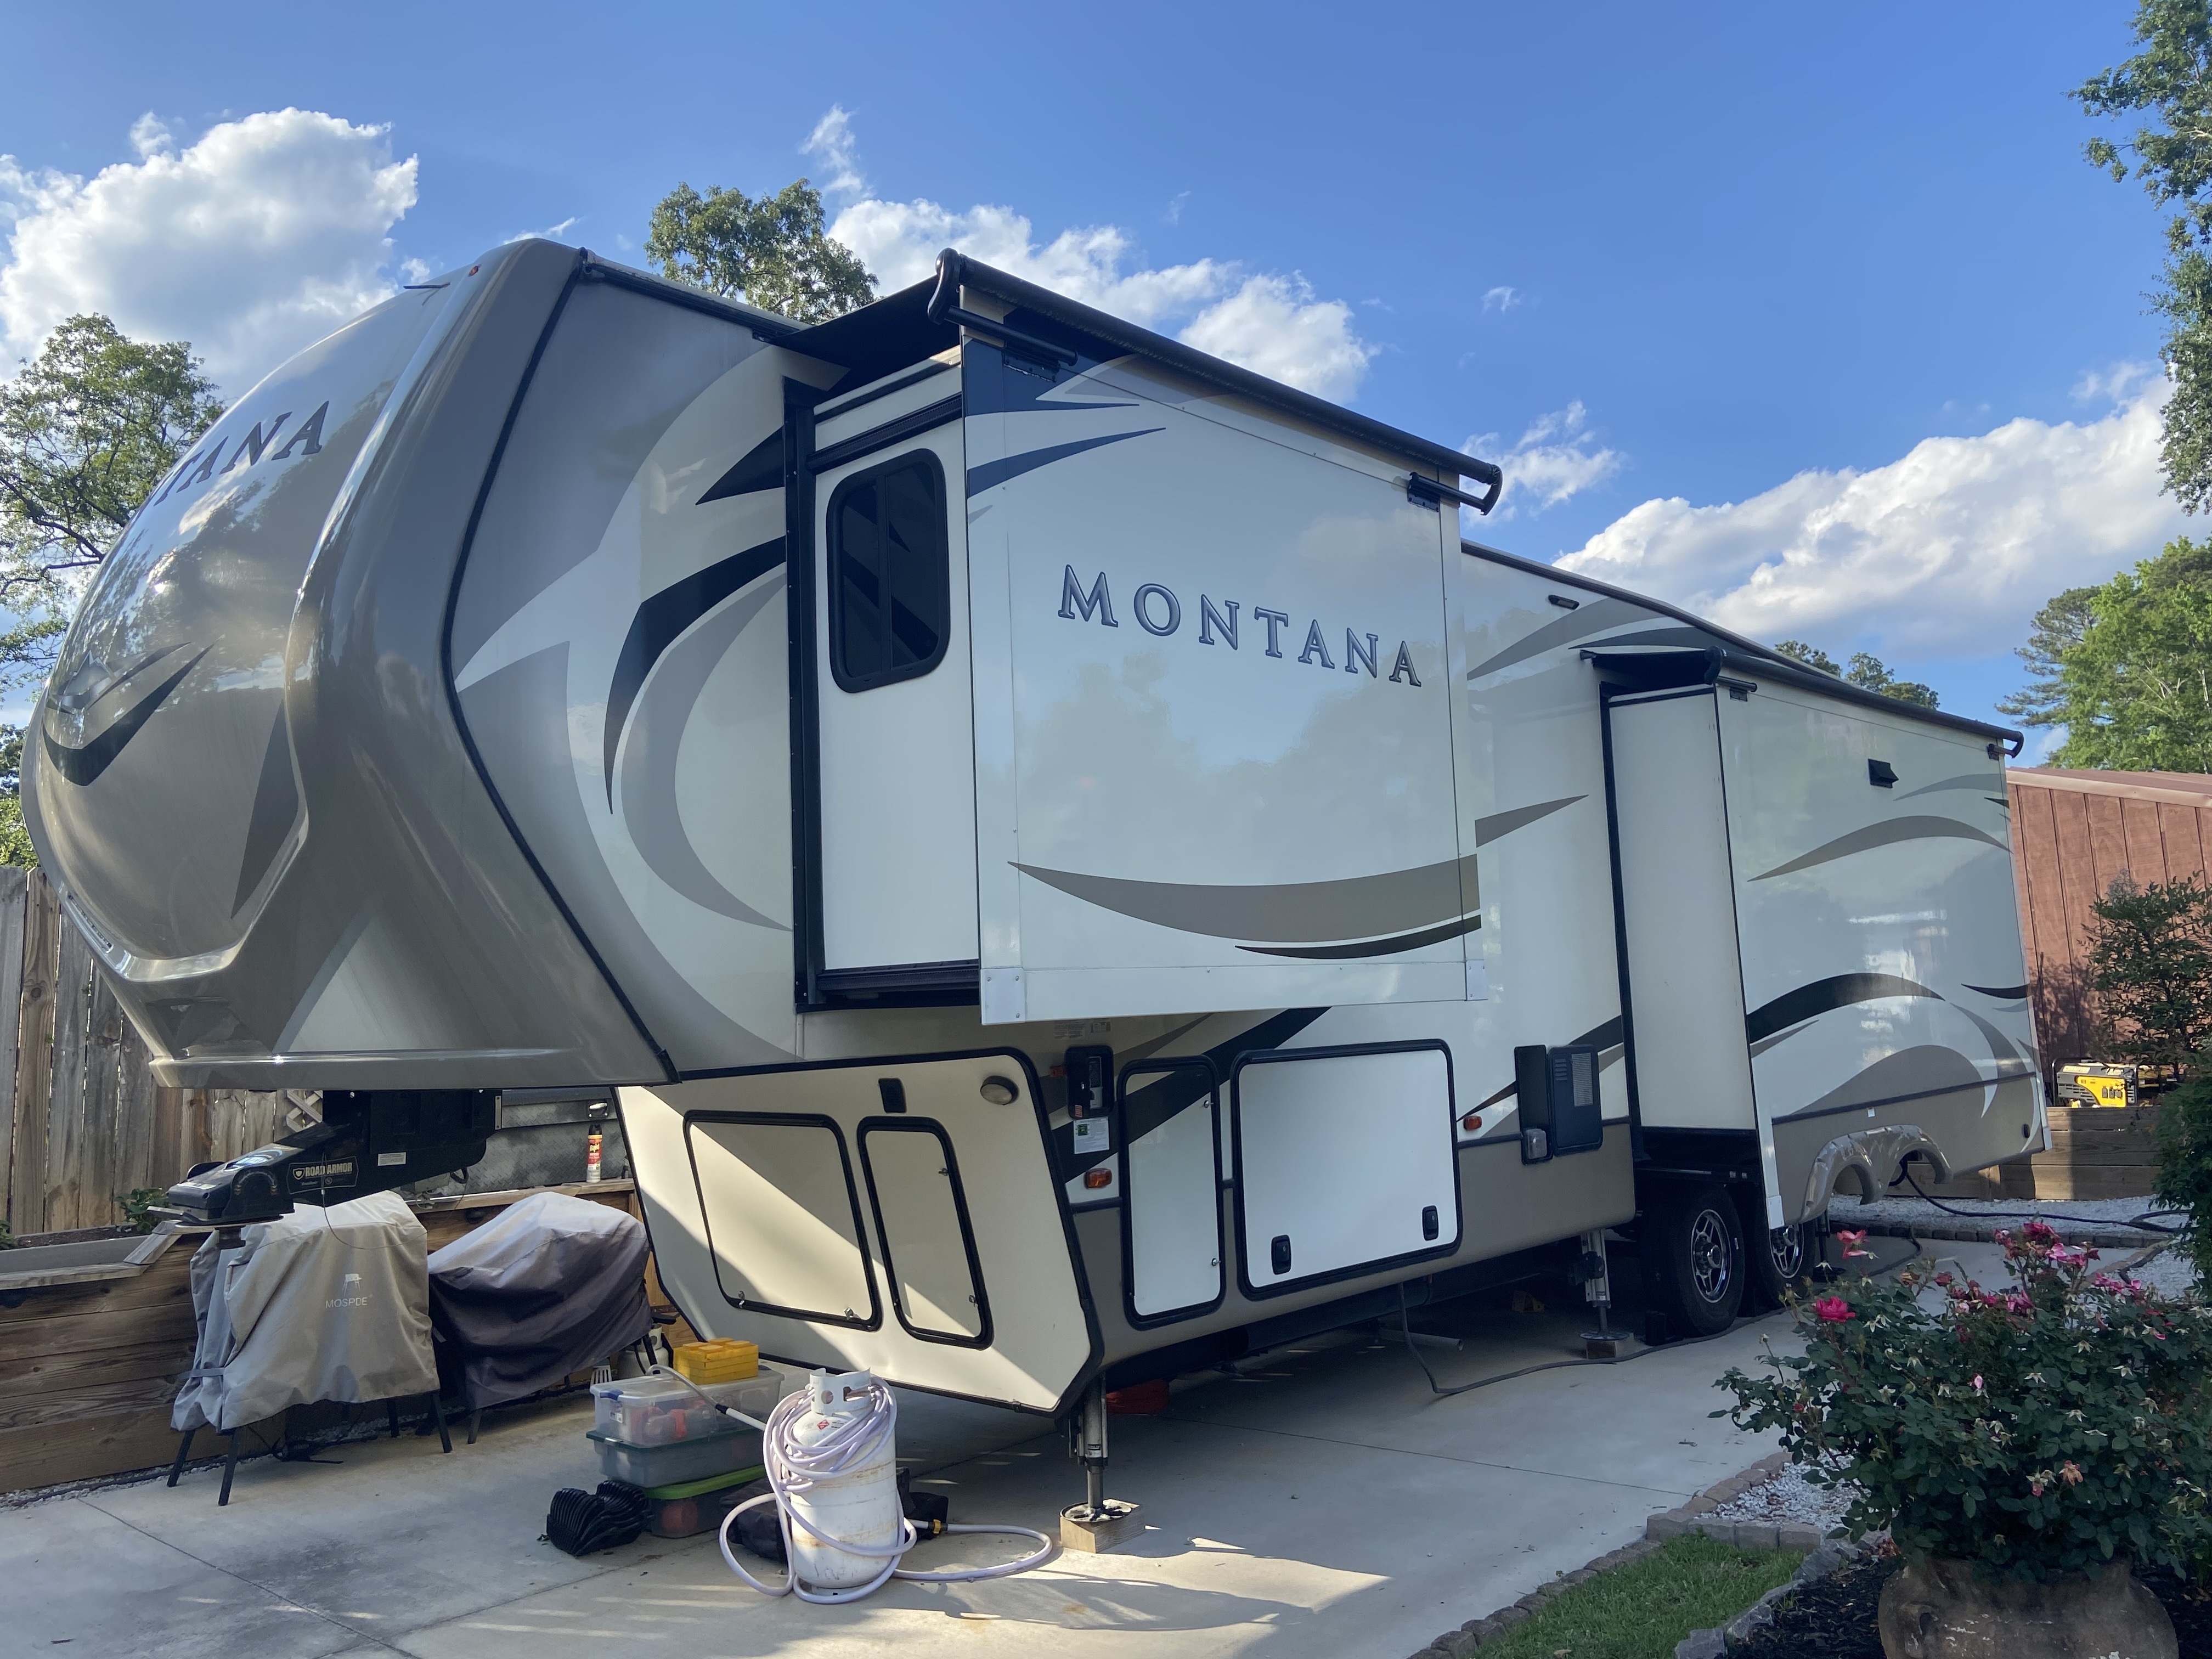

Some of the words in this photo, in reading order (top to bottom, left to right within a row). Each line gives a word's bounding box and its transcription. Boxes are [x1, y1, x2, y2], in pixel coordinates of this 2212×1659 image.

[147, 400, 330, 507] TANA
[1057, 564, 1422, 688] MONTANA
[305, 1165, 325, 1177] ROAD
[326, 1163, 353, 1175] ARMOR
[325, 1296, 368, 1309] MOSPDE
